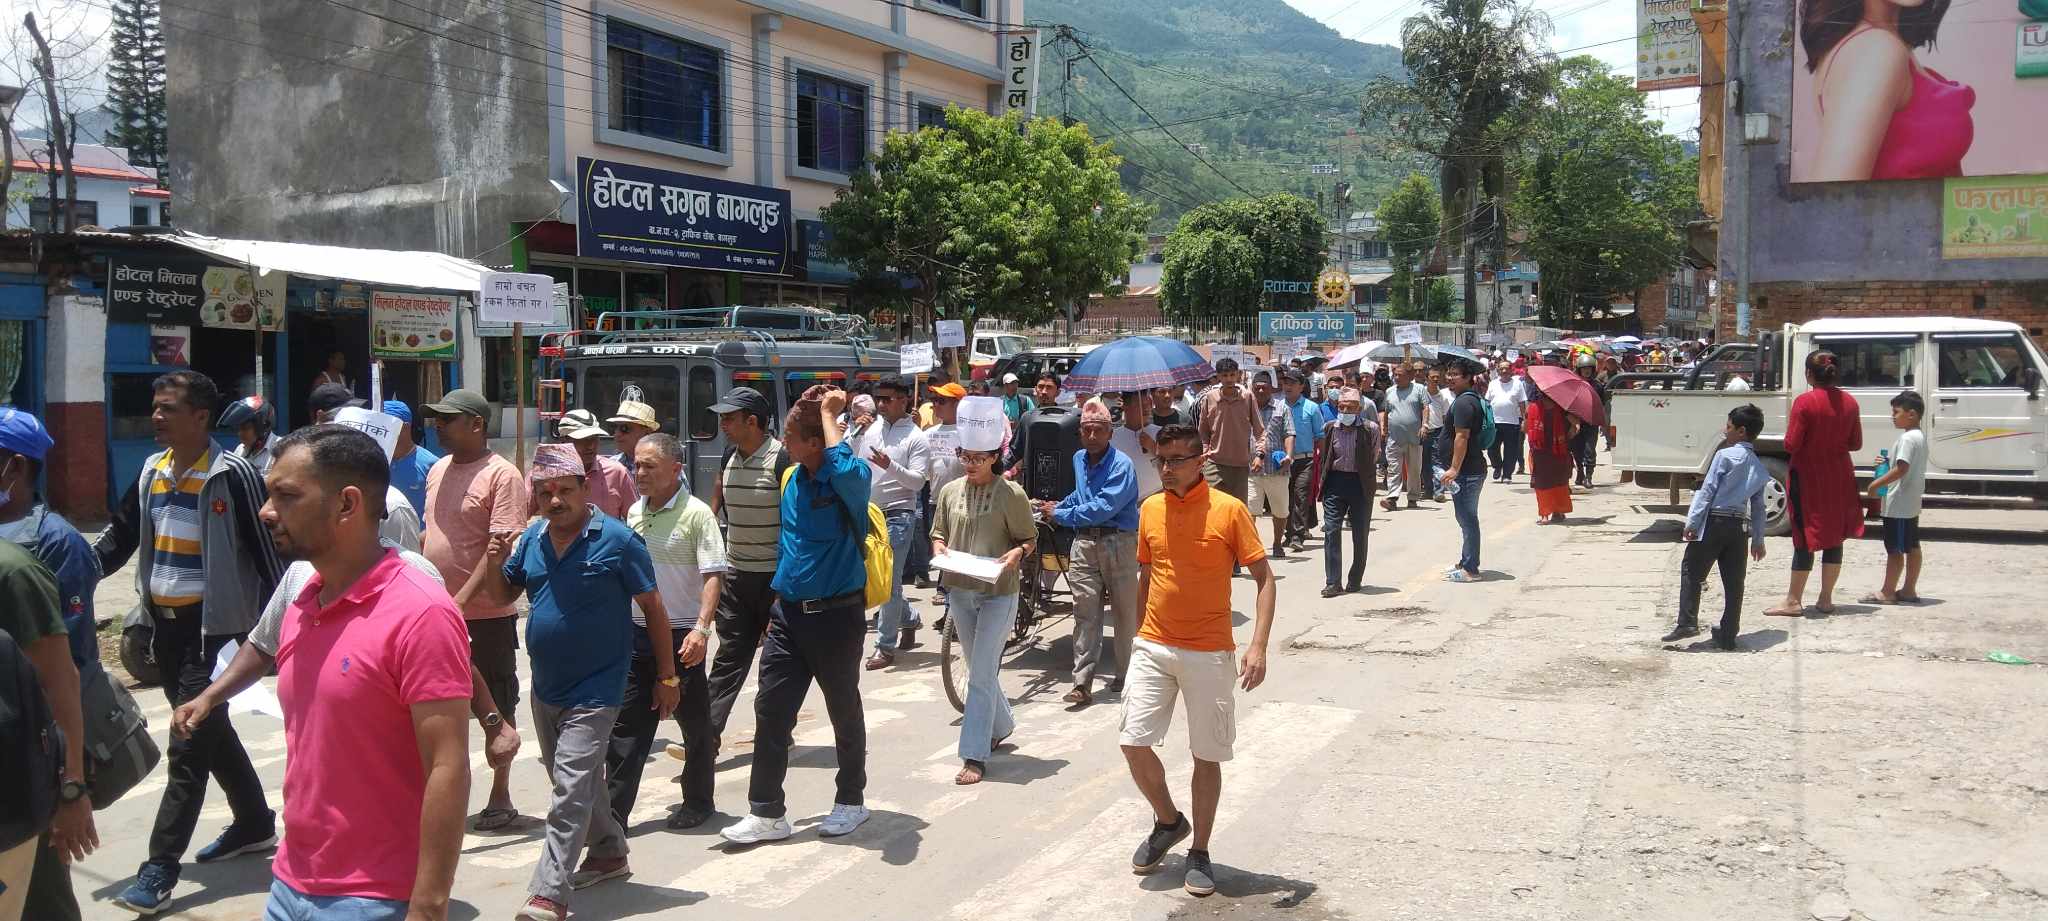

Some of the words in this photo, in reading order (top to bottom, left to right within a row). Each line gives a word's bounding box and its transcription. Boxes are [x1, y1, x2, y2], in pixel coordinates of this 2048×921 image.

[1008, 36, 1032, 108] होटल
[593, 166, 654, 211] होटल
[660, 184, 711, 225] सगुन
[716, 193, 780, 233] बागलुङ
[115, 265, 152, 283] होटल
[157, 268, 197, 286] मिलन
[113, 288, 141, 303] एण्ड
[1264, 279, 1312, 294] Rotary
[1270, 314, 1314, 334] ट्राफिक
[1318, 315, 1344, 330] चोक
